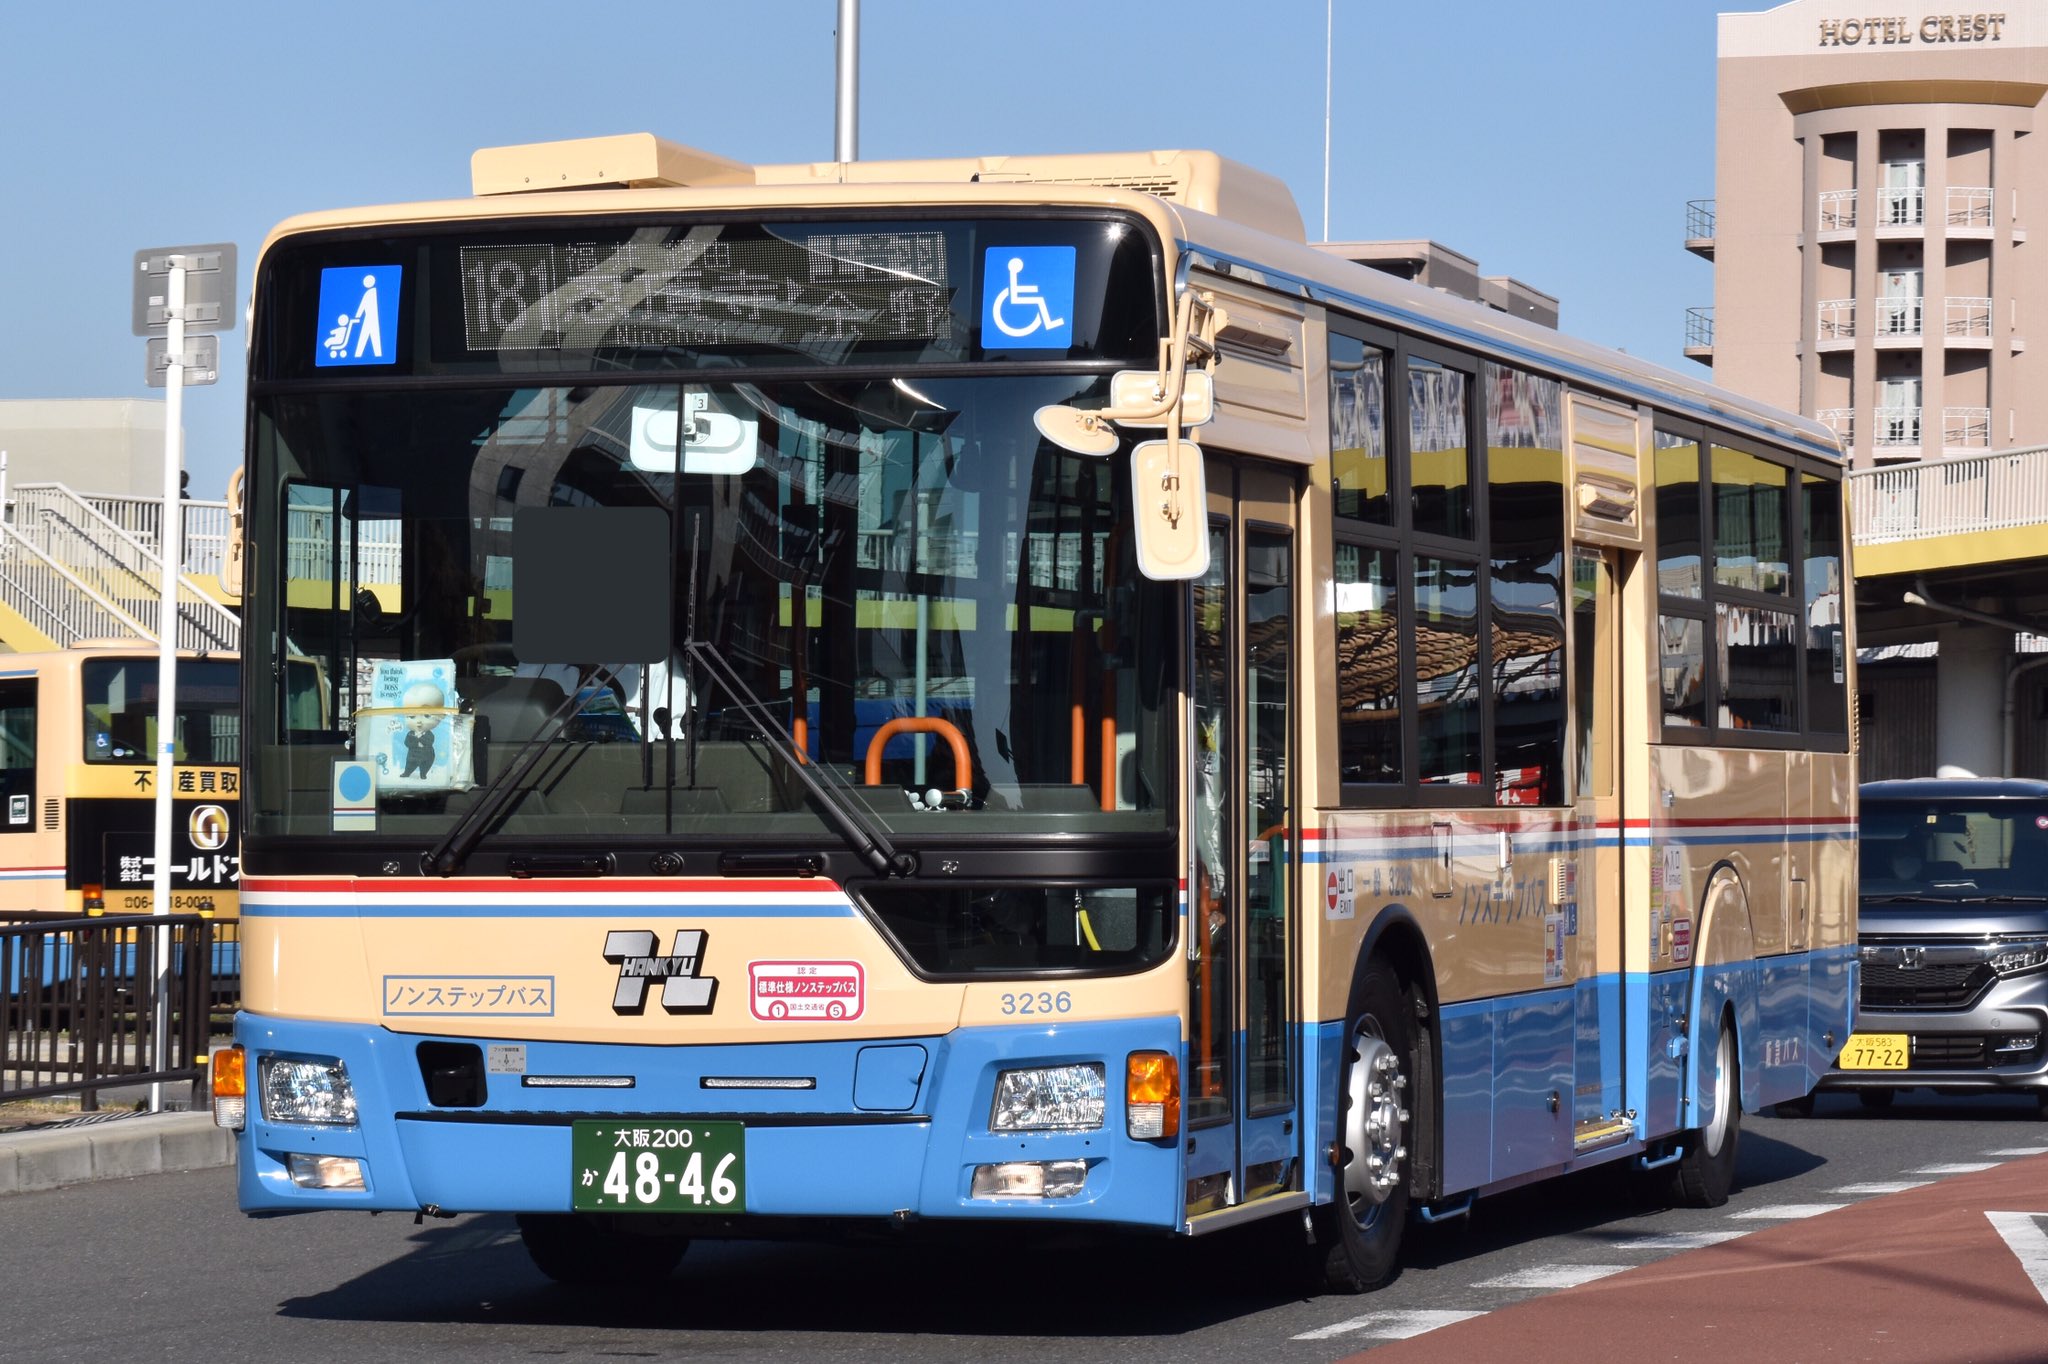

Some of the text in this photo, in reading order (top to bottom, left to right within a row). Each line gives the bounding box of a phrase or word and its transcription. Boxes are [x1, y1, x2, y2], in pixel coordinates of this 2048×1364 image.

[1819, 13, 2007, 45] HOTEL CREST
[467, 260, 551, 333] 181
[615, 323, 728, 346] Ninchoji
[134, 770, 238, 794] 不産買取
[1338, 867, 1354, 895] 出口
[1388, 865, 1413, 897] 3236
[1339, 899, 1352, 914] EXIT
[1458, 874, 1548, 926] ノンステップバス
[619, 957, 697, 977] HANKYU
[796, 966, 818, 976] 認定
[389, 984, 549, 1008] ノンステップバス
[758, 980, 856, 995] 標準仕様ノンステップバス
[774, 1006, 782, 1016] 1
[789, 1002, 825, 1012] 国土交通省
[832, 1006, 840, 1016] 5
[1000, 990, 1073, 1016] 3236
[1855, 1049, 1904, 1066] 77-22
[613, 1128, 694, 1148] 大阪200
[581, 1151, 737, 1205] か 48-46
